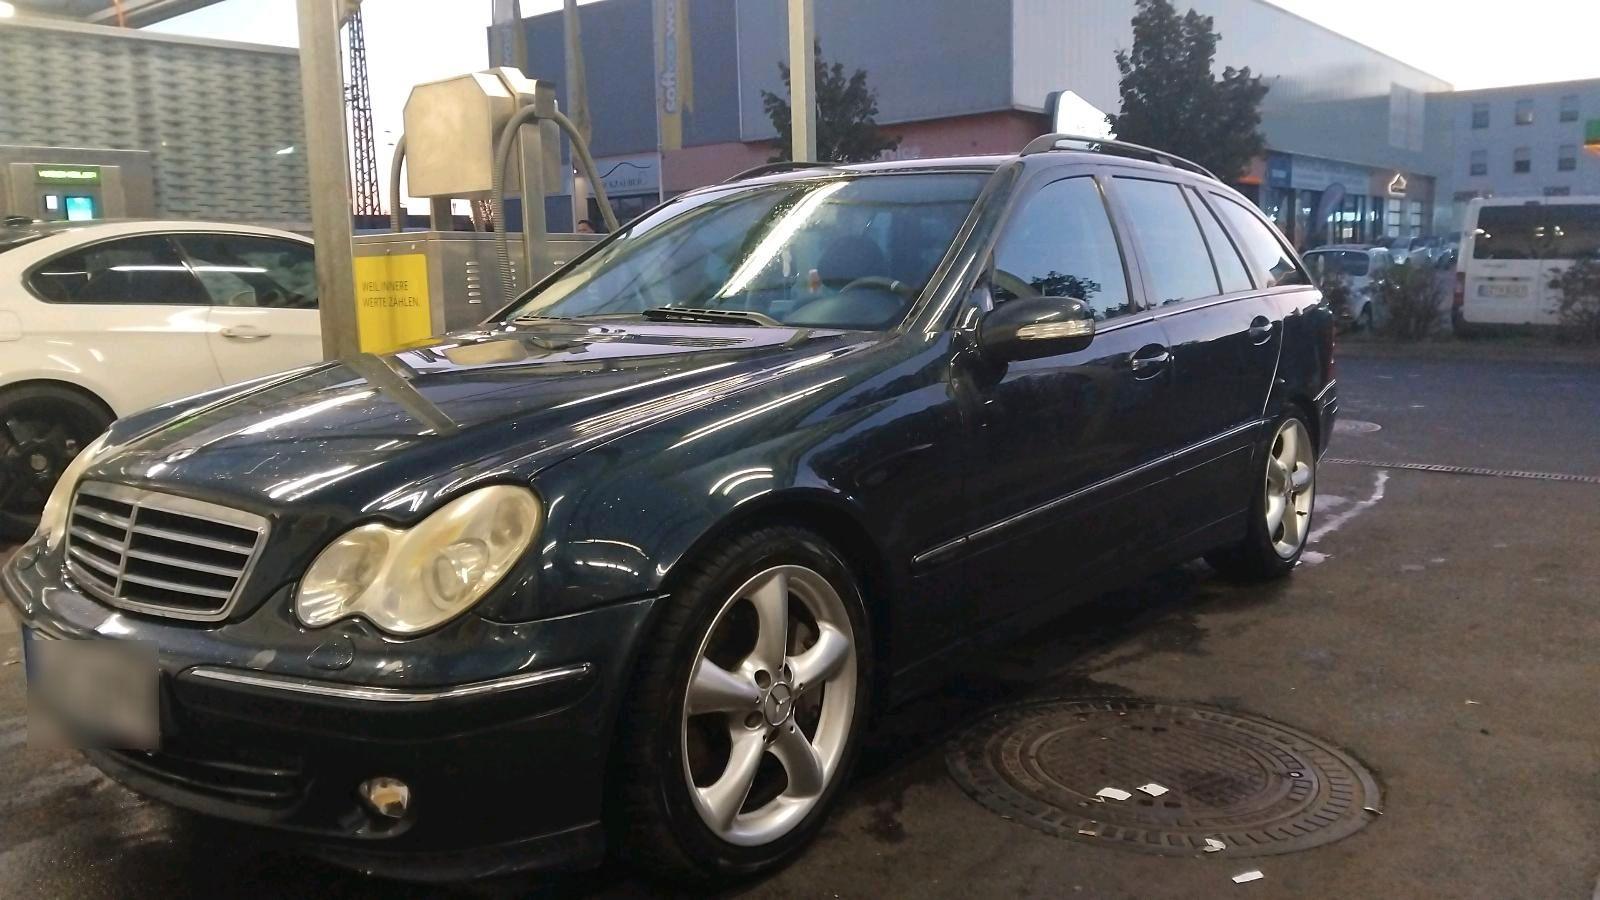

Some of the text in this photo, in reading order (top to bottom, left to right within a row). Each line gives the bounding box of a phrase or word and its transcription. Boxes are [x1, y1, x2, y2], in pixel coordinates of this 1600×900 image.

[362, 280, 409, 292] WEIL INNERE
[362, 297, 387, 308] WERTE
